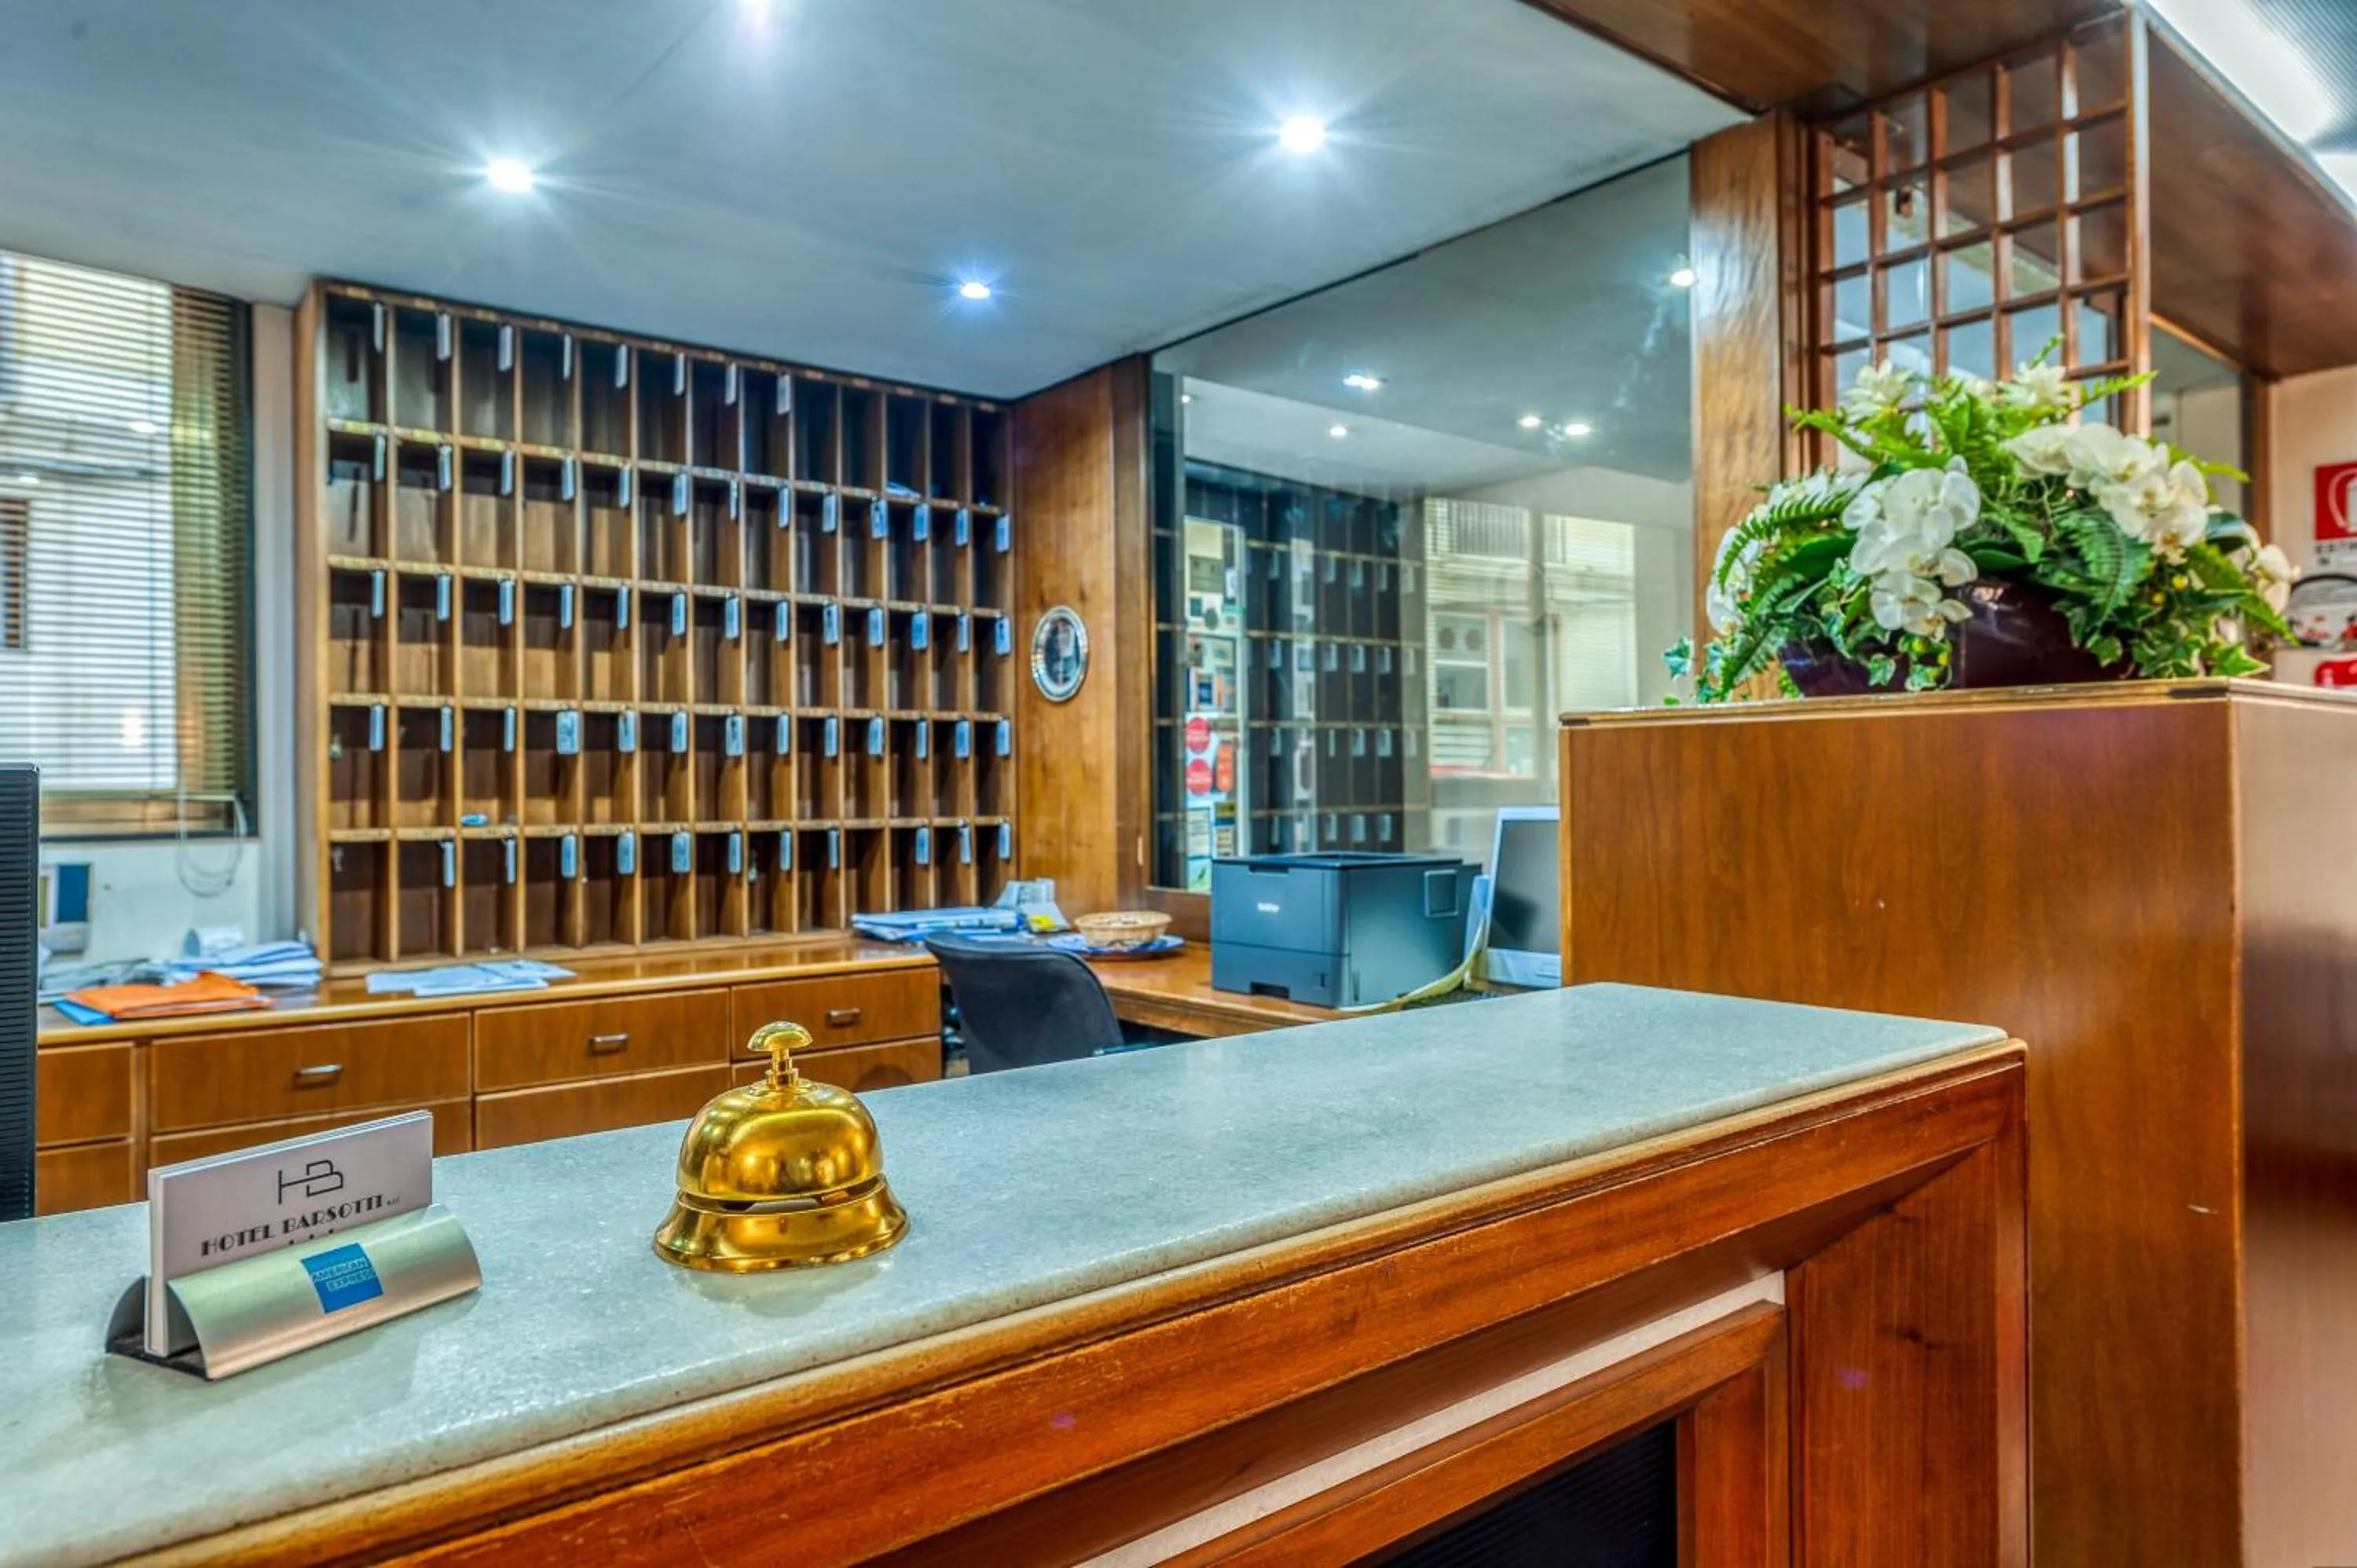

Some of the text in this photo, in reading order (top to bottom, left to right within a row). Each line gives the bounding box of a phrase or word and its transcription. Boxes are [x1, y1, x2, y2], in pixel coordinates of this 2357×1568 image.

[202, 1224, 275, 1256] HOTEL
[283, 1194, 383, 1234] BARSOTTI
[312, 1256, 369, 1282] AMERICAN
